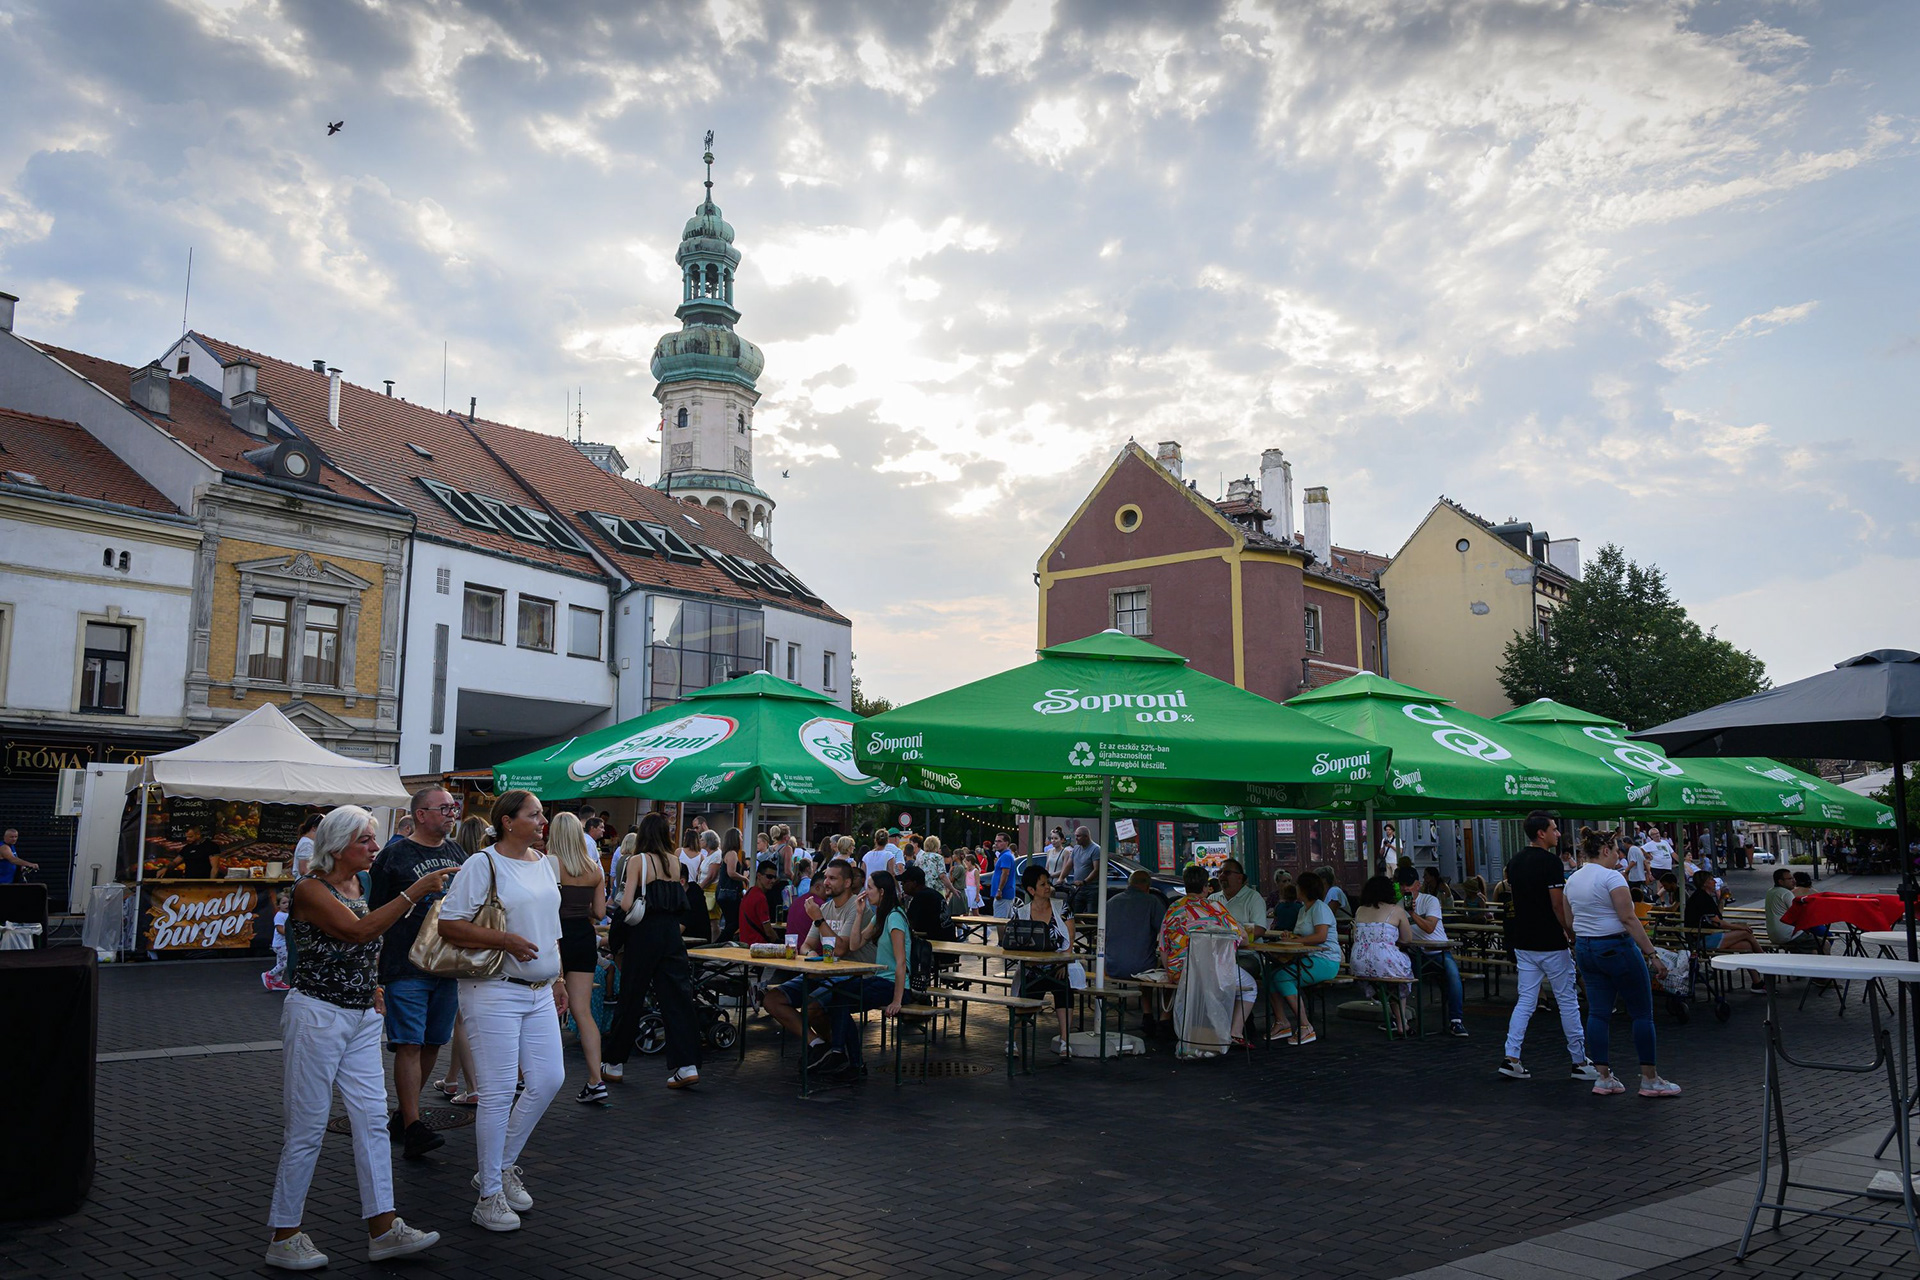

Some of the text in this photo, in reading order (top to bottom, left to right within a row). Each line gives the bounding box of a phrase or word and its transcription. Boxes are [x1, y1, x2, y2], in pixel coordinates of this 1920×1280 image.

[1033, 689, 1188, 715] Soproni
[866, 732, 923, 755] Soproni
[1099, 742, 1107, 750] Ez
[1117, 742, 1140, 751] eszköz
[1141, 744, 1170, 753] 52%-ban
[16, 747, 82, 769] RÓMA
[1099, 760, 1168, 770] műanyagból készült.
[1312, 750, 1371, 776] Soproni
[412, 858, 462, 879] HARD ROC
[154, 885, 250, 929] Smash
[153, 912, 253, 949] burger
